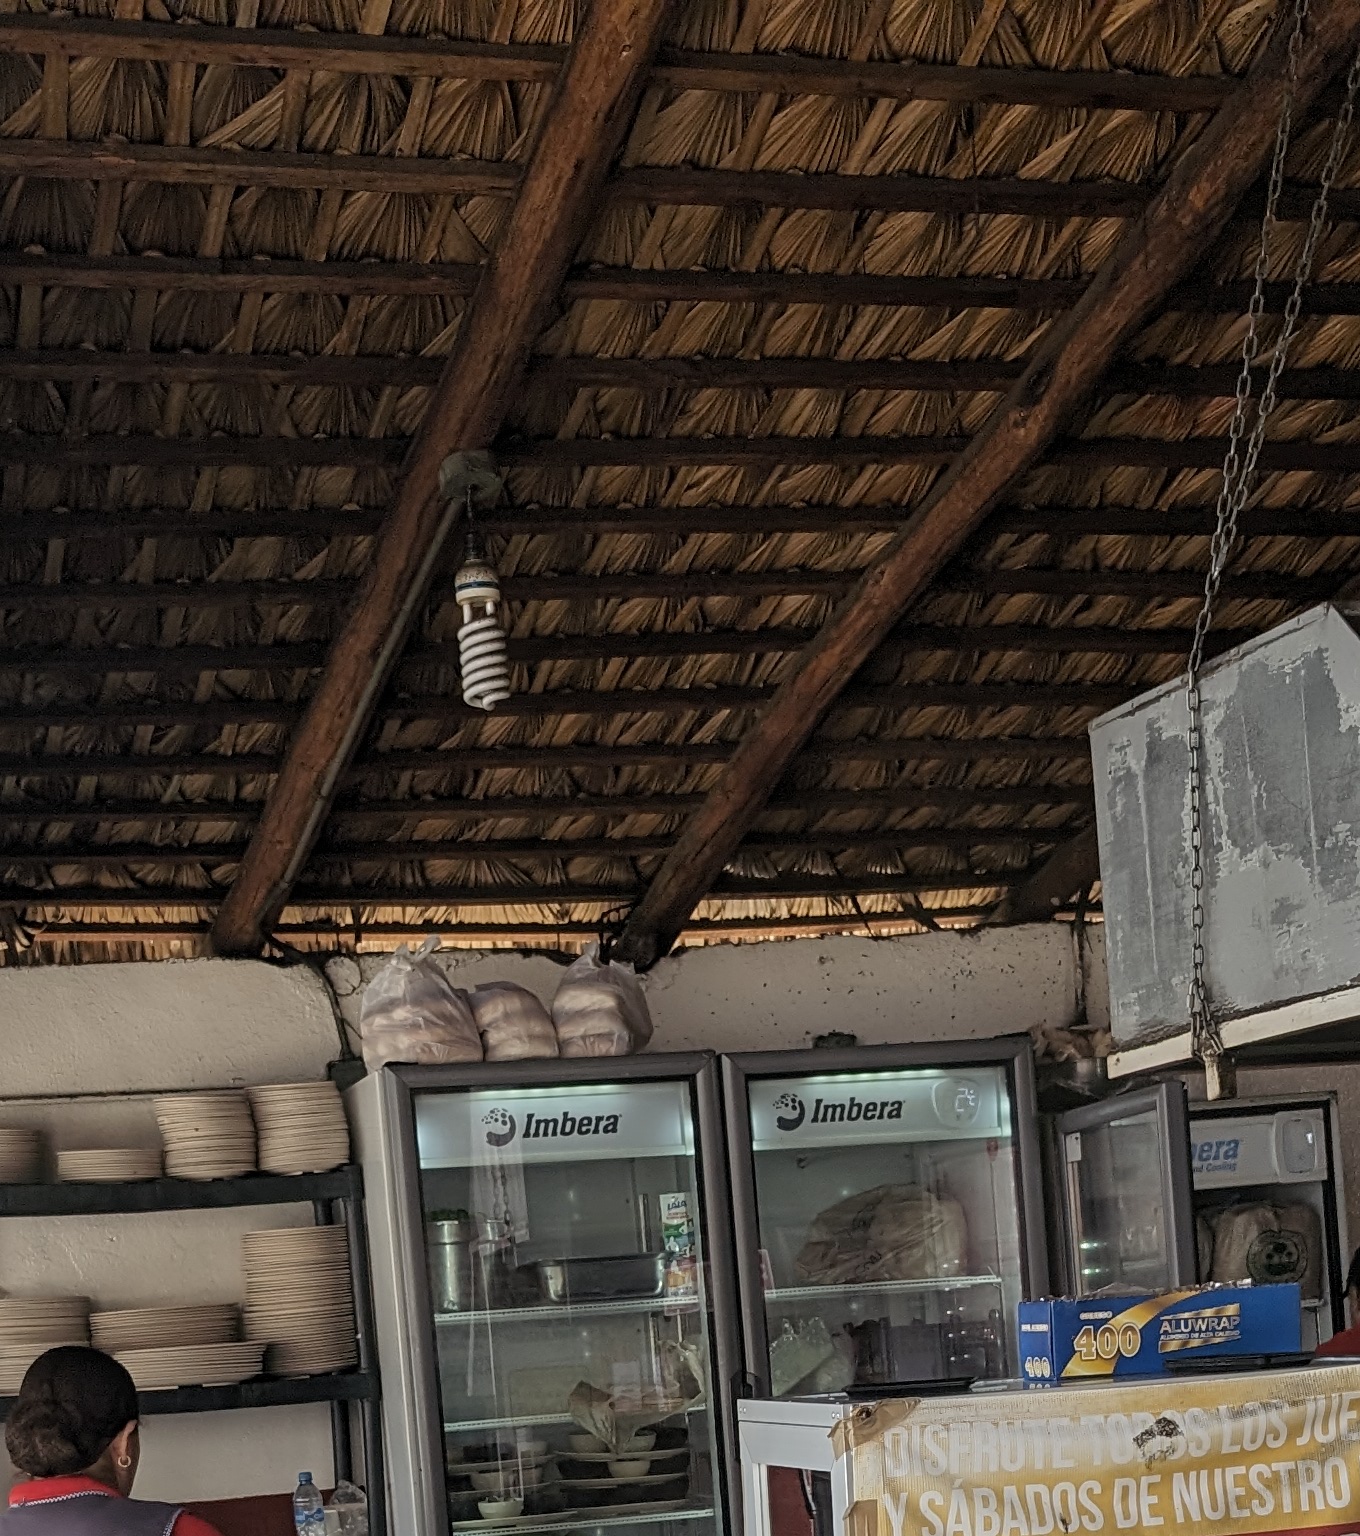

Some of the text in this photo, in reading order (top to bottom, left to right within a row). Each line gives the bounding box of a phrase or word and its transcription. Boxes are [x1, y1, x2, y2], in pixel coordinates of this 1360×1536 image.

[522, 1110, 620, 1139] Imbera
[811, 1097, 902, 1124] Imbera
[1160, 1316, 1240, 1334] ALUWRAP
[1073, 1323, 1140, 1360] 400
[1025, 1356, 1050, 1378] 400
[884, 1416, 1078, 1477] DISFRUTE
[1217, 1400, 1290, 1455] LOS
[1114, 1476, 1166, 1529] DE
[1172, 1457, 1351, 1524] NUESTRO
